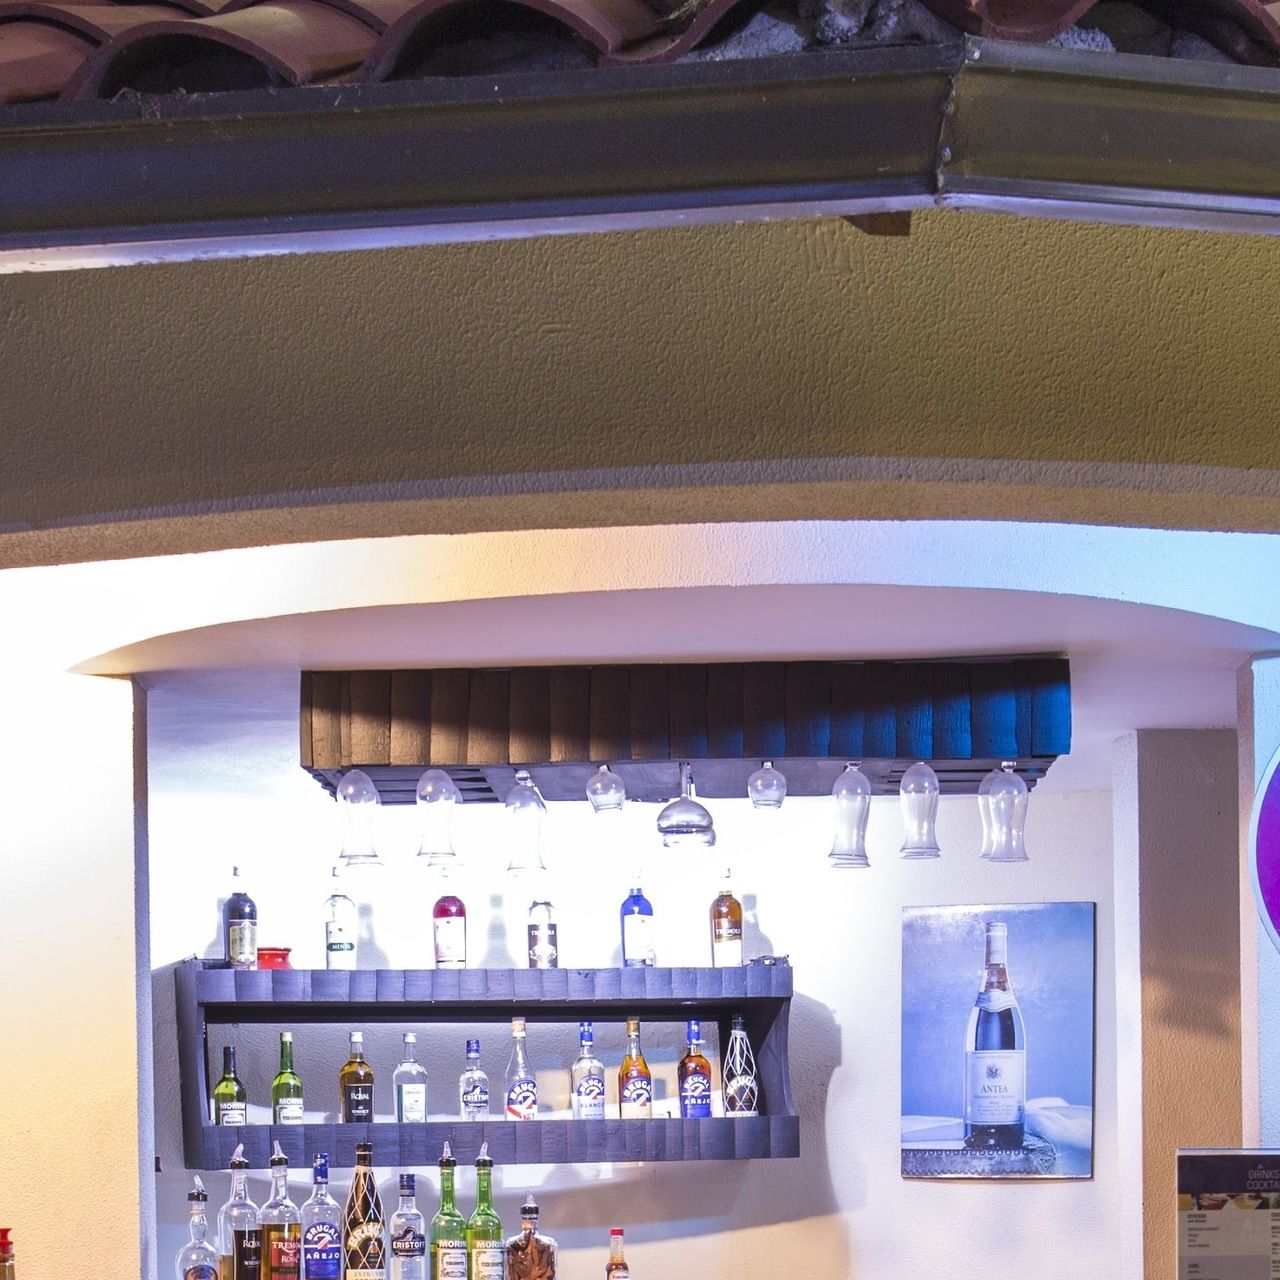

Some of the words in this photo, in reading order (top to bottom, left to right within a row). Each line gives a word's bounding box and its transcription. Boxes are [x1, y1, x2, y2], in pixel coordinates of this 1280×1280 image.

[981, 1084, 1009, 1094] ANTEA
[221, 1102, 246, 1110] MORIN
[1248, 1169, 1280, 1179] DRINKS
[306, 1225, 339, 1240] BRUGAL
[306, 1251, 340, 1260] AÑEJO
